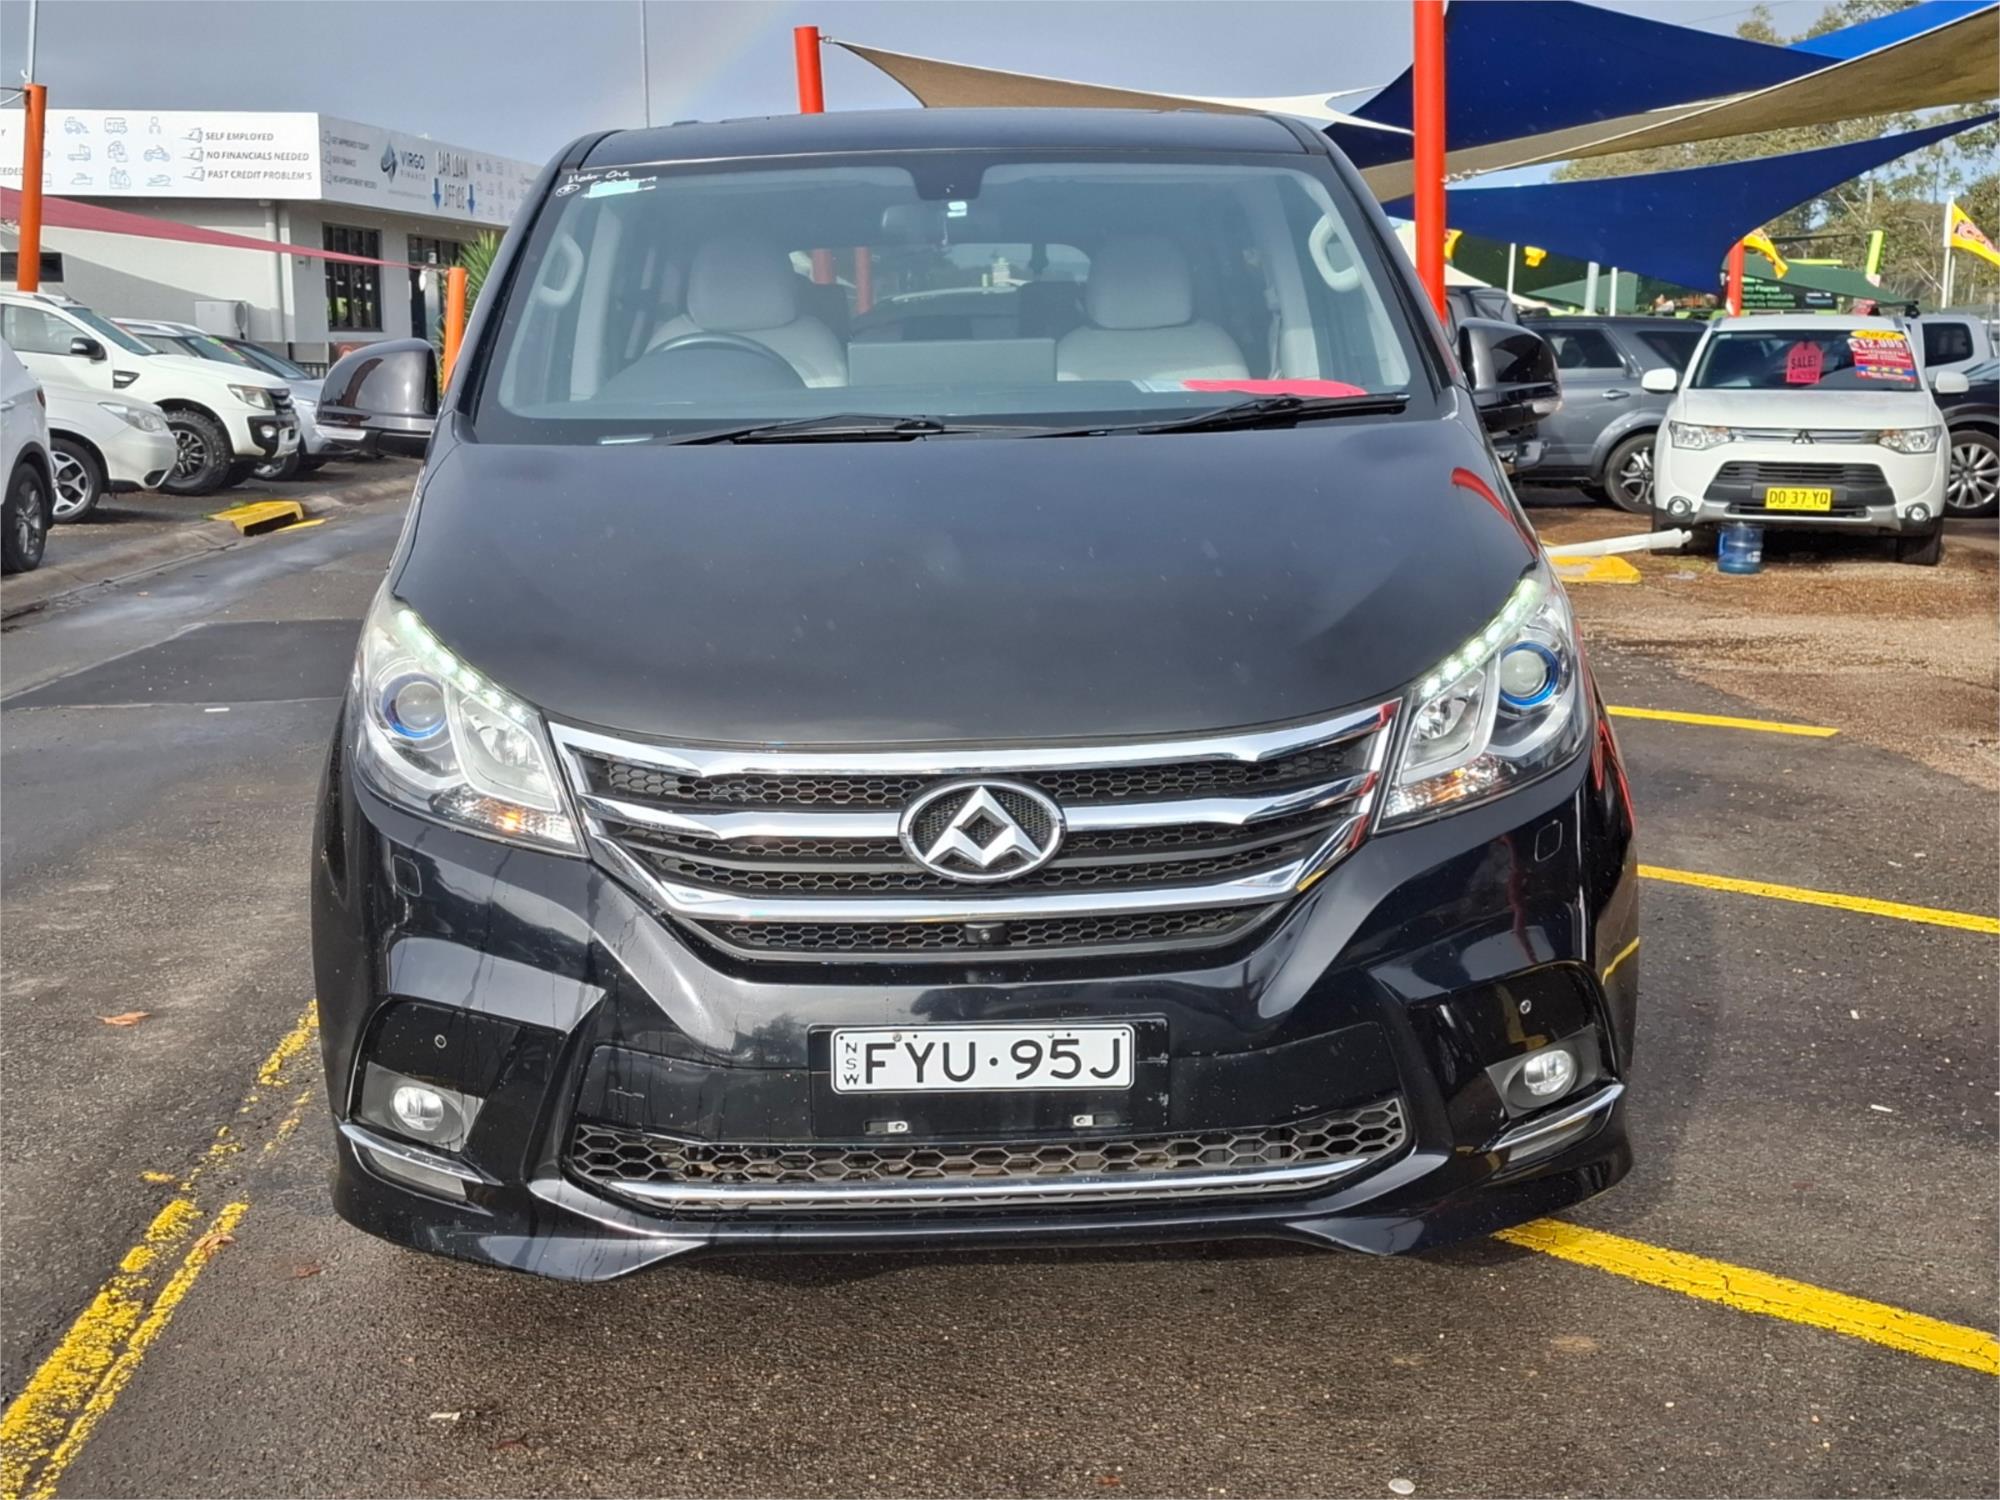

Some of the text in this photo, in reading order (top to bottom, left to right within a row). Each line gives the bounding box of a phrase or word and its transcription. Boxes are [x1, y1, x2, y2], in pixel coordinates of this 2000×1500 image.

[205, 132, 274, 141] SELF EMPLOYED
[206, 151, 310, 161] NO FINANCIALS NEEDED
[400, 150, 426, 170] VIRGO
[438, 151, 468, 180] CAR LOAN
[207, 170, 313, 181] PAST CREDIT PROBLEM'S
